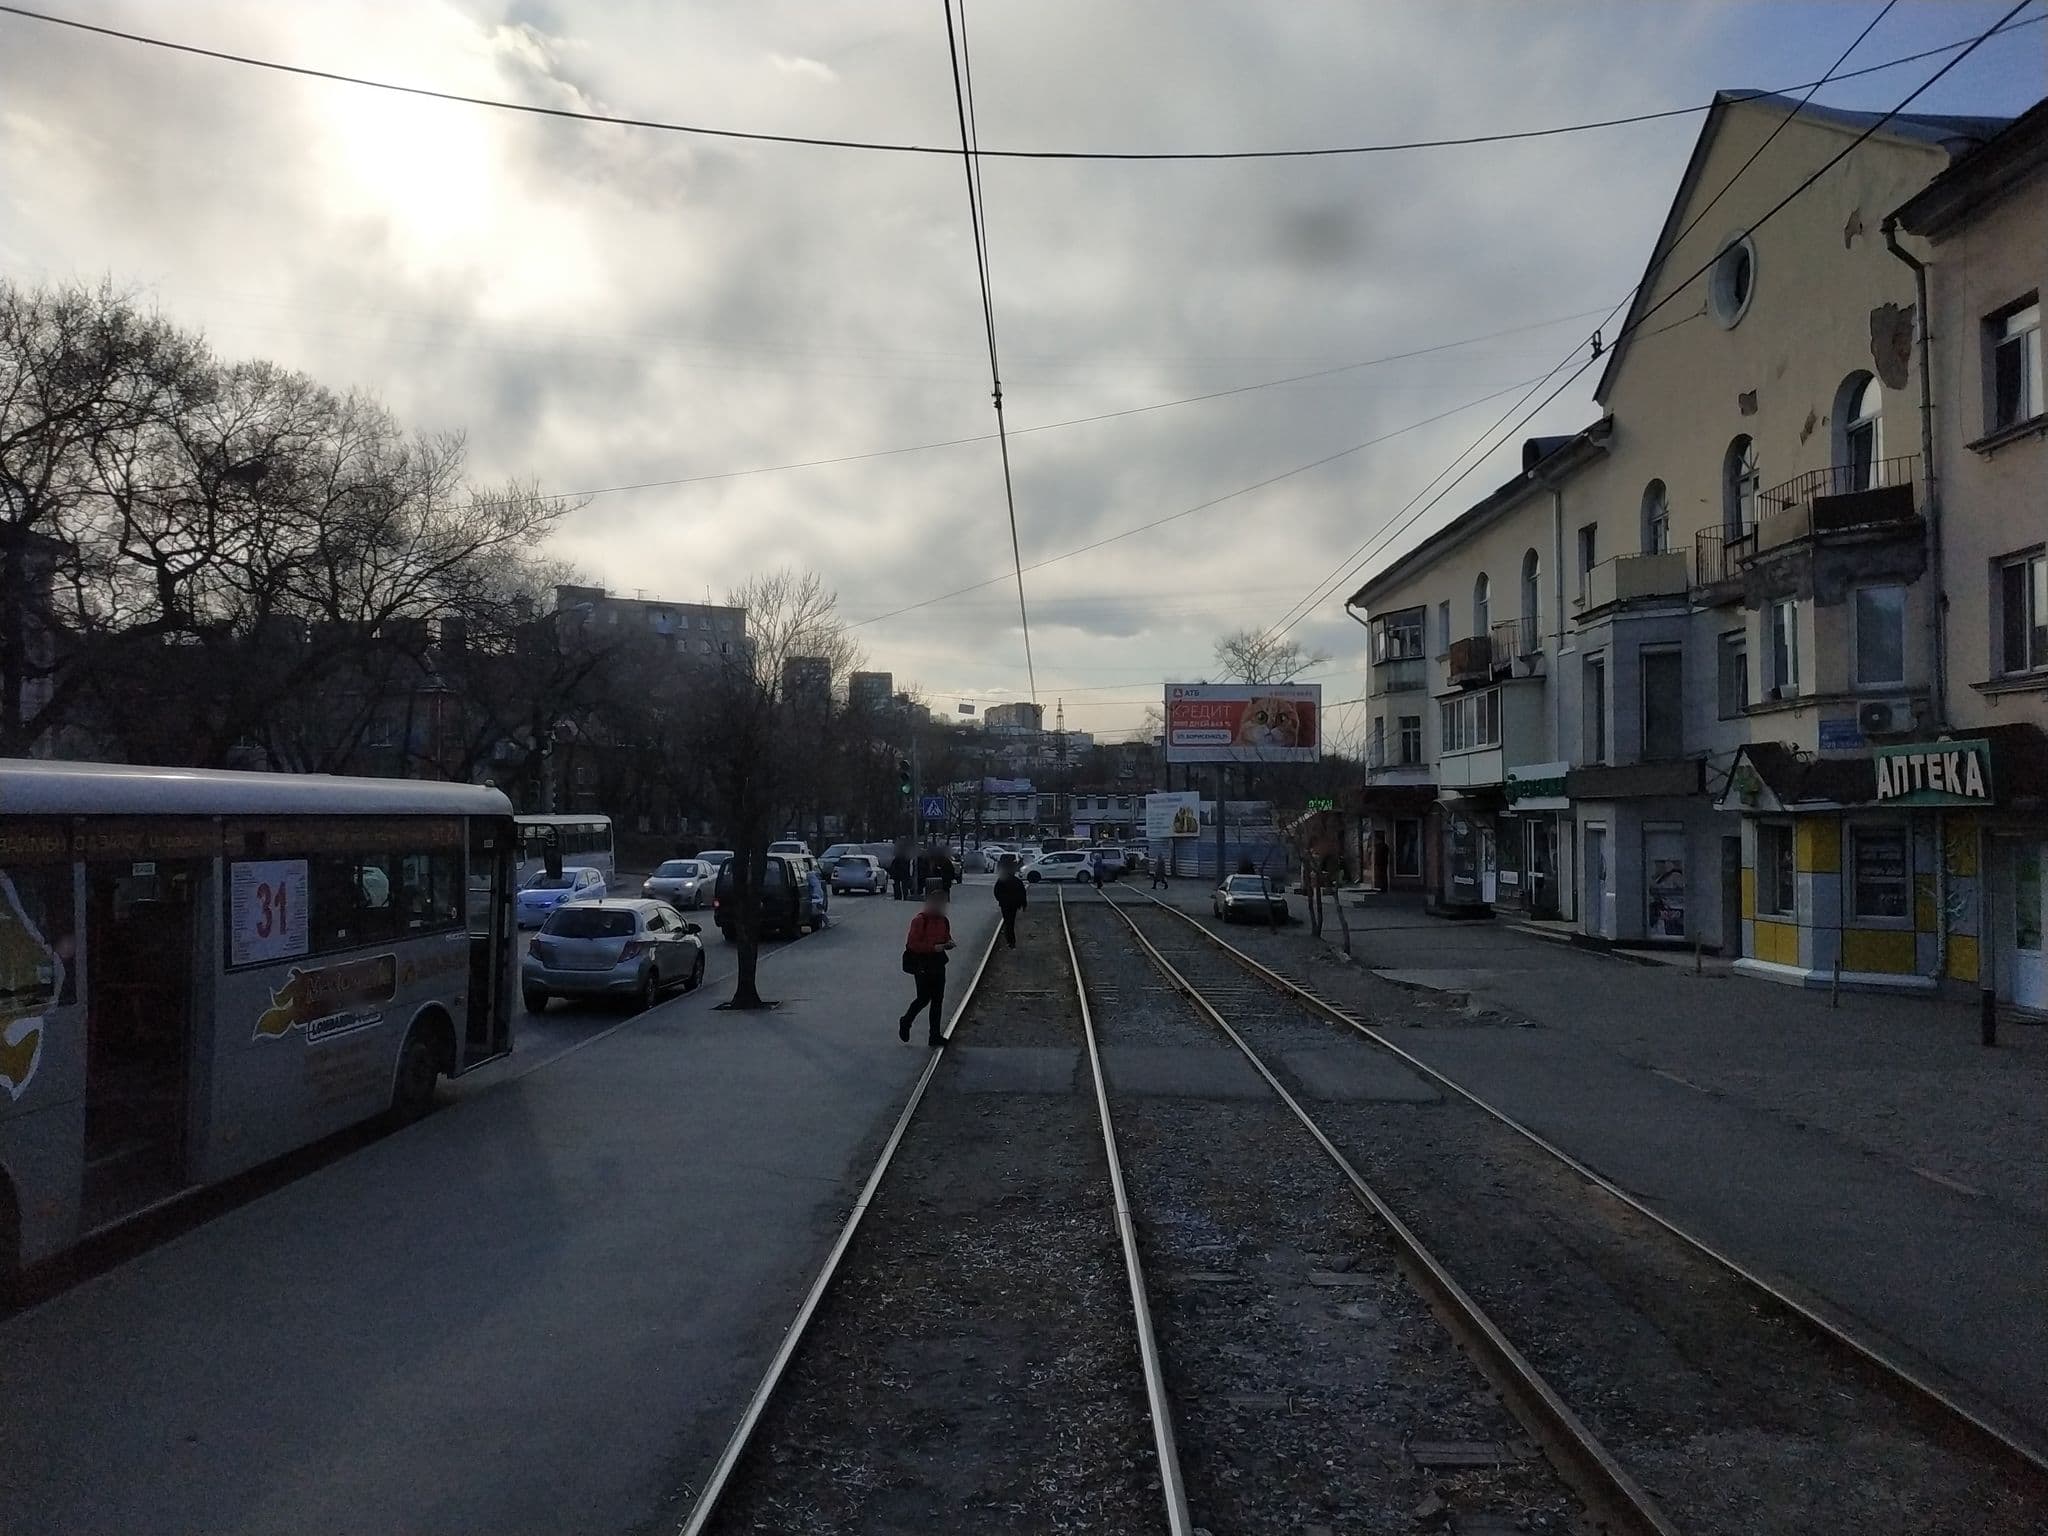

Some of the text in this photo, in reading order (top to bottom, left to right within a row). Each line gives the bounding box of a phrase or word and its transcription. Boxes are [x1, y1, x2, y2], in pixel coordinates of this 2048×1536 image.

[1184, 689, 1200, 697] АТБ
[1172, 704, 1232, 720] КРЕДИТ
[1877, 751, 1985, 800] АПТЕКА
[256, 881, 287, 938] 31
